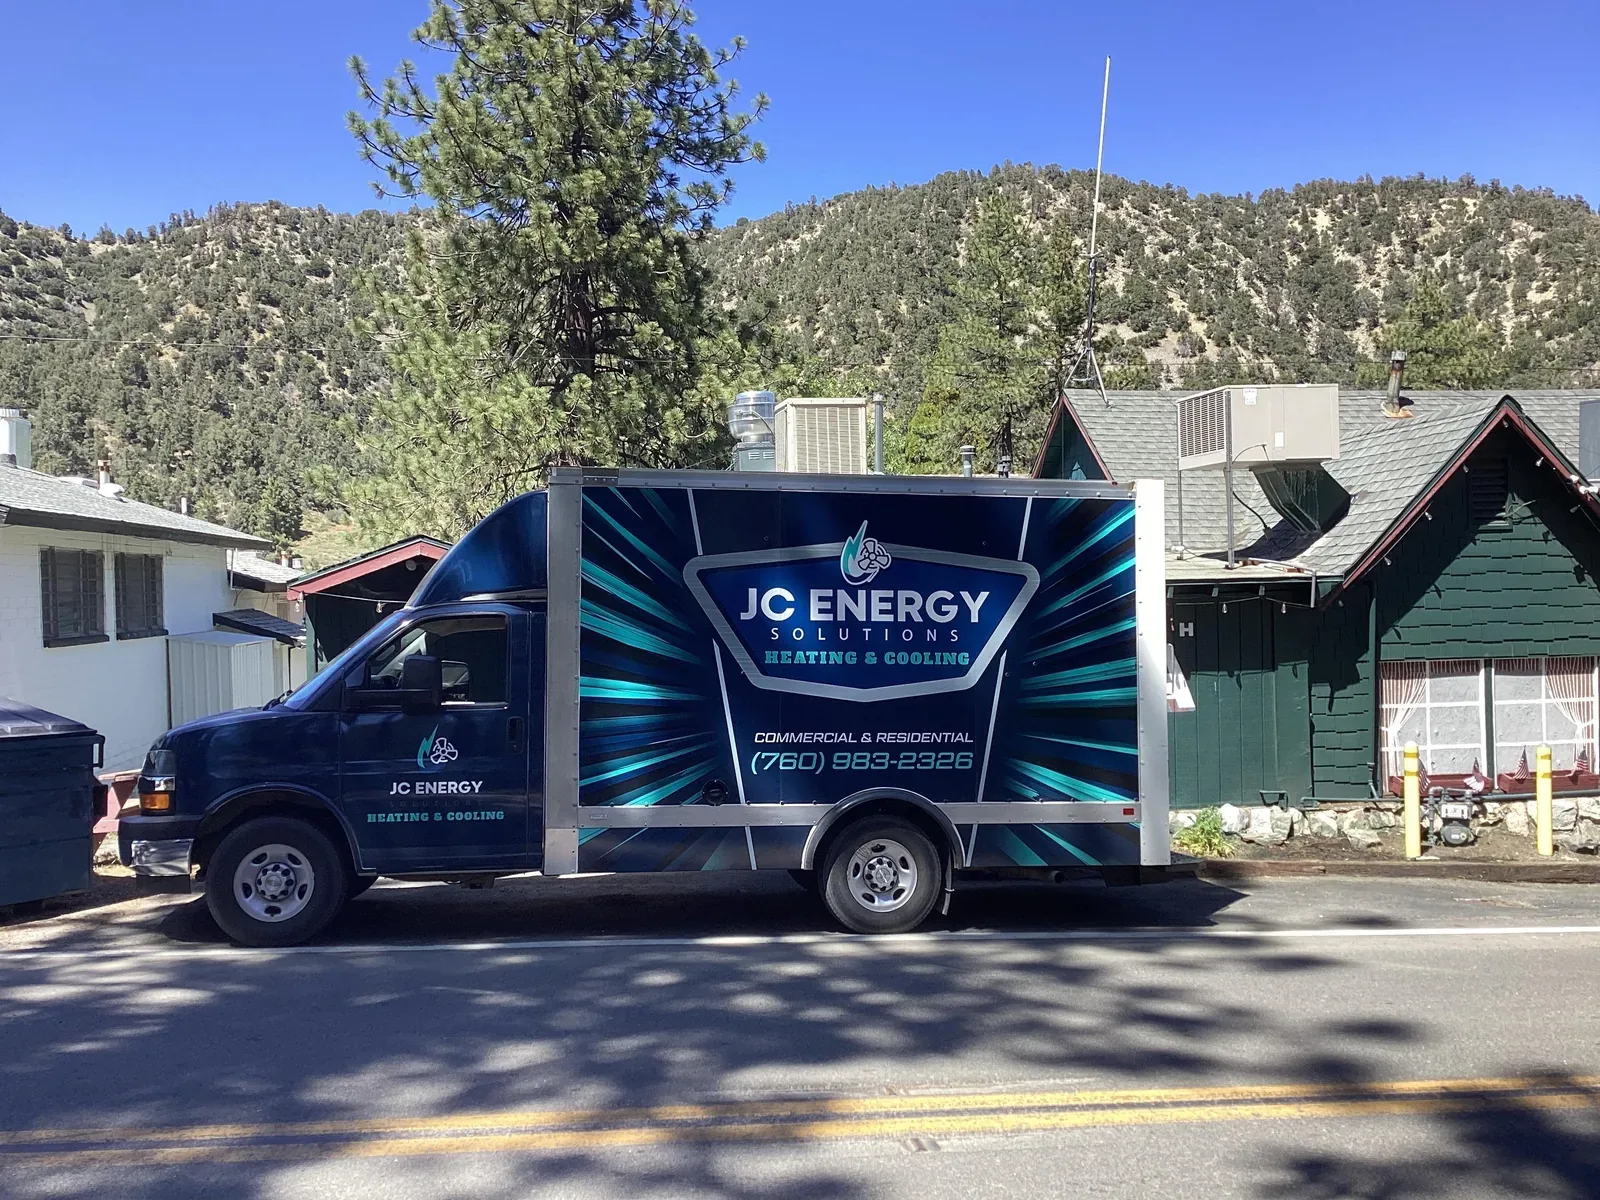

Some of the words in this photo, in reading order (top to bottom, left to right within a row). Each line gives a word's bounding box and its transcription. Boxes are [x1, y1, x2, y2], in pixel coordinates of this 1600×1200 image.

[740, 587, 795, 622] JC
[809, 589, 990, 623] ENERGY
[771, 626, 959, 642] SOLUTIONS
[764, 650, 857, 665] HEATING
[864, 651, 878, 664] &
[884, 652, 970, 666] COOLING
[754, 732, 857, 743] COMMERCIAL
[861, 732, 872, 743] &
[876, 732, 974, 743] RESIDENTIAL
[750, 751, 825, 775] (760)
[832, 752, 973, 770] 983-2326
[390, 782, 411, 795] JC
[415, 780, 483, 794] ENERGY
[367, 813, 429, 823] HEATING
[433, 813, 442, 821] &
[446, 811, 504, 821] COOLING
